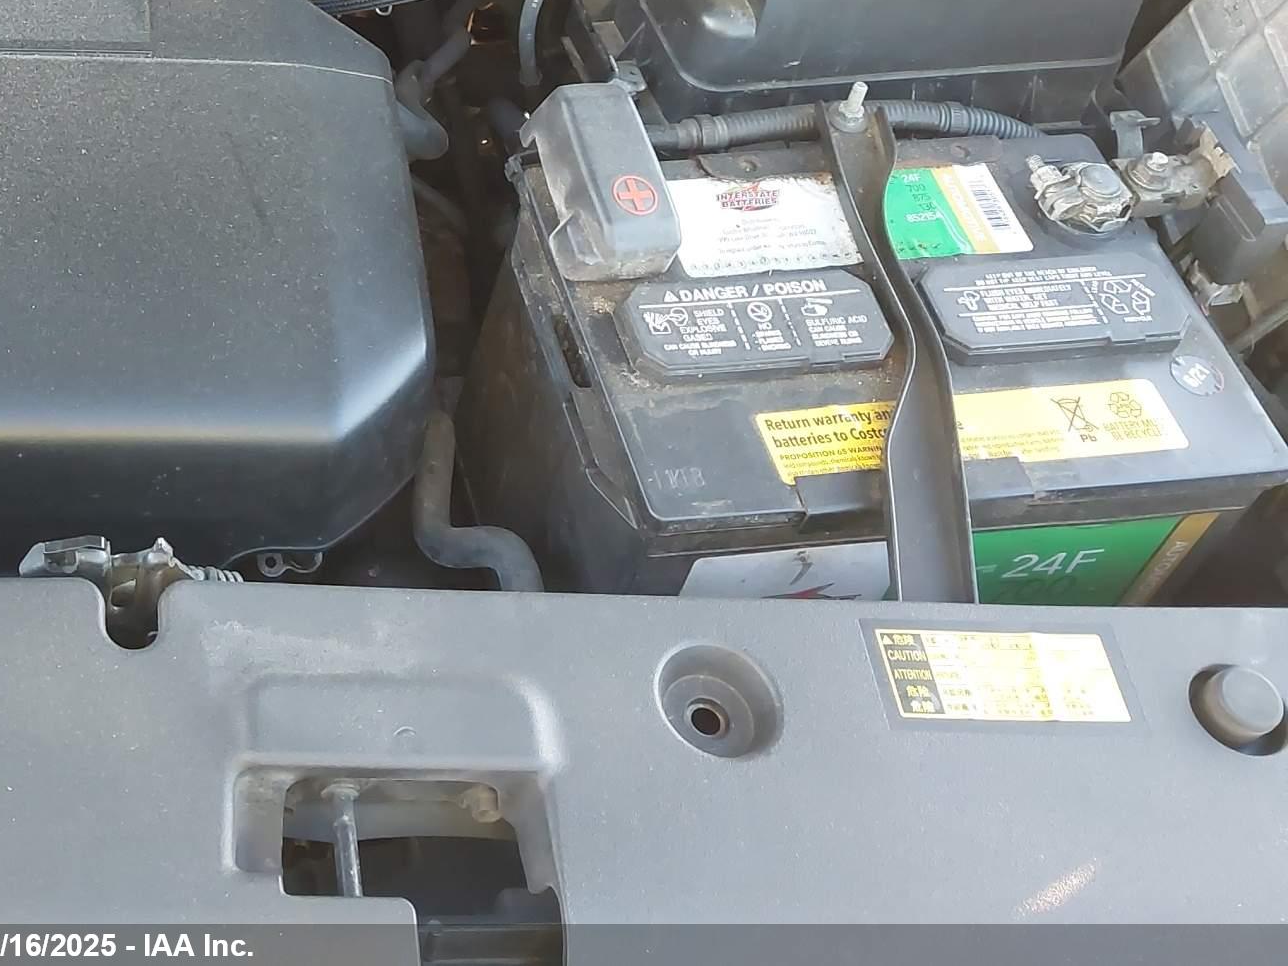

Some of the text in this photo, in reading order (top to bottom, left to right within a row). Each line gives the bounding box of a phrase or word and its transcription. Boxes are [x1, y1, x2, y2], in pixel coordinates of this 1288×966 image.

[902, 173, 920, 183] 24F
[905, 184, 926, 193] 700
[716, 189, 778, 202] INTERSTATE
[721, 197, 777, 208] BATTERIES
[679, 285, 749, 302] DANGER
[762, 279, 827, 296] POISON
[693, 308, 725, 317] SHIELD
[697, 317, 720, 325] EYES
[805, 315, 867, 327] SULFURIC ACID
[765, 407, 895, 431] Return warranty an
[772, 432, 832, 448] batteries
[834, 431, 848, 442] to
[1080, 433, 1097, 443] Pb
[780, 449, 835, 461] PROPOSITION
[849, 446, 882, 454] WARNIN
[1002, 548, 1105, 579] 24F
[887, 649, 928, 662] CAUTION
[893, 668, 933, 681] ATTENTION
